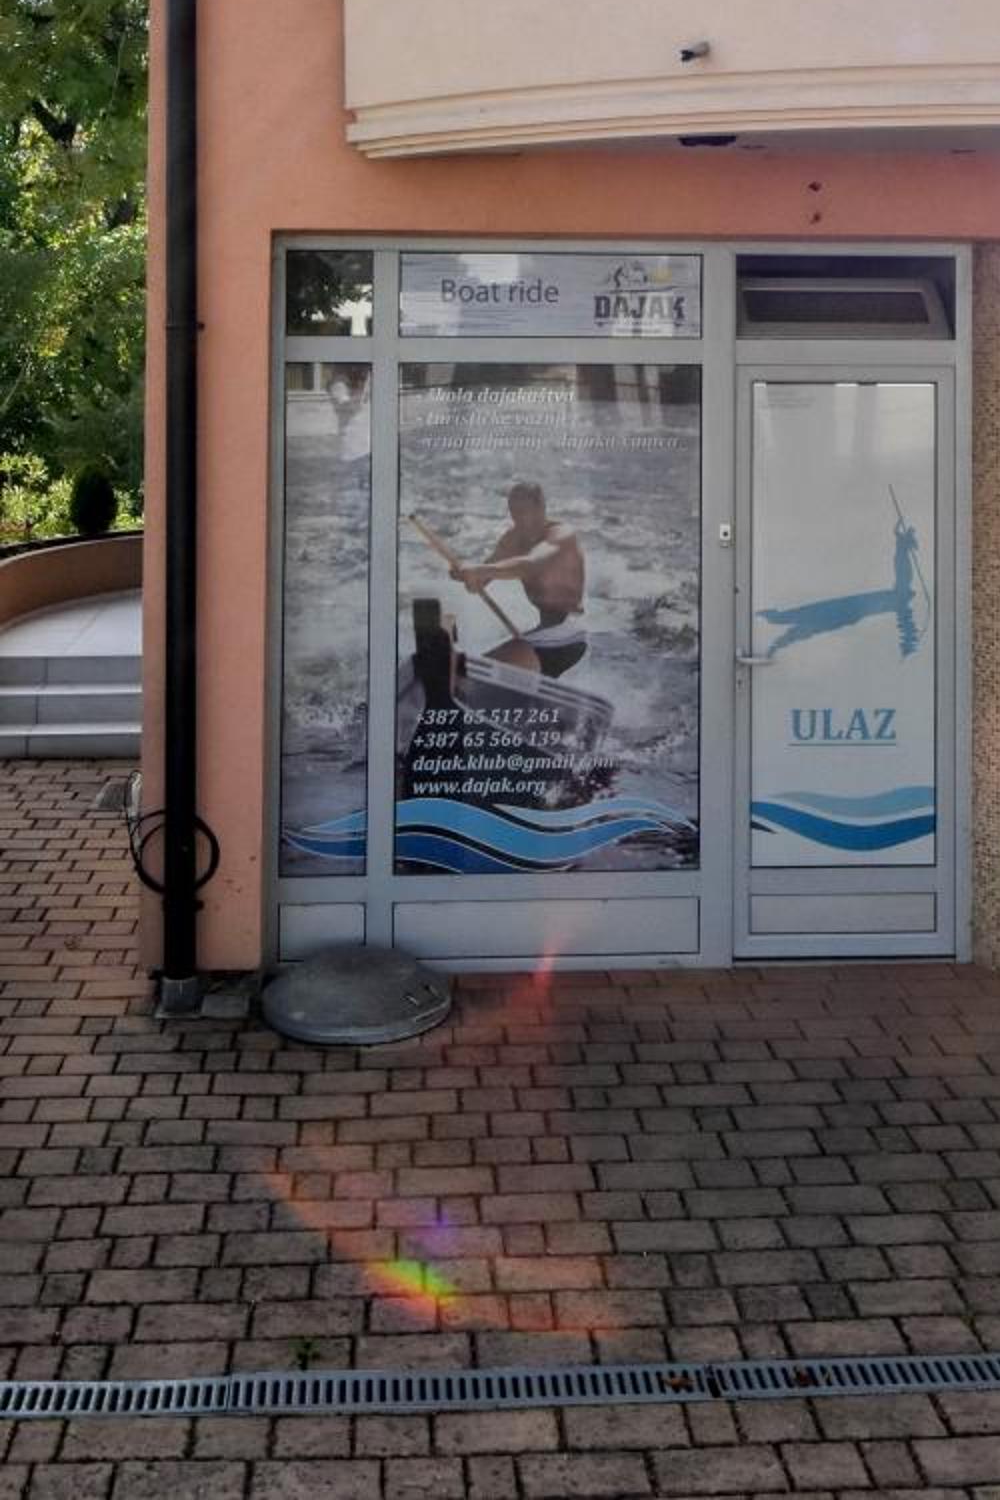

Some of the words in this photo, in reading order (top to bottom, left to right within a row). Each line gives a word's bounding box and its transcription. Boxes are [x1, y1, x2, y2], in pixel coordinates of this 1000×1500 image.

[441, 279, 500, 303] Boat
[508, 279, 560, 303] ride
[594, 295, 686, 319] DAJAK
[415, 708, 460, 725] +387
[463, 708, 486, 725] 65
[489, 708, 523, 725] 517
[527, 708, 561, 724] 261
[791, 708, 897, 741] ULAZ
[413, 731, 459, 748] +387
[463, 731, 486, 747] 65
[489, 731, 524, 748] 566
[529, 731, 562, 748] 139
[412, 777, 547, 797] www.dajak.org
